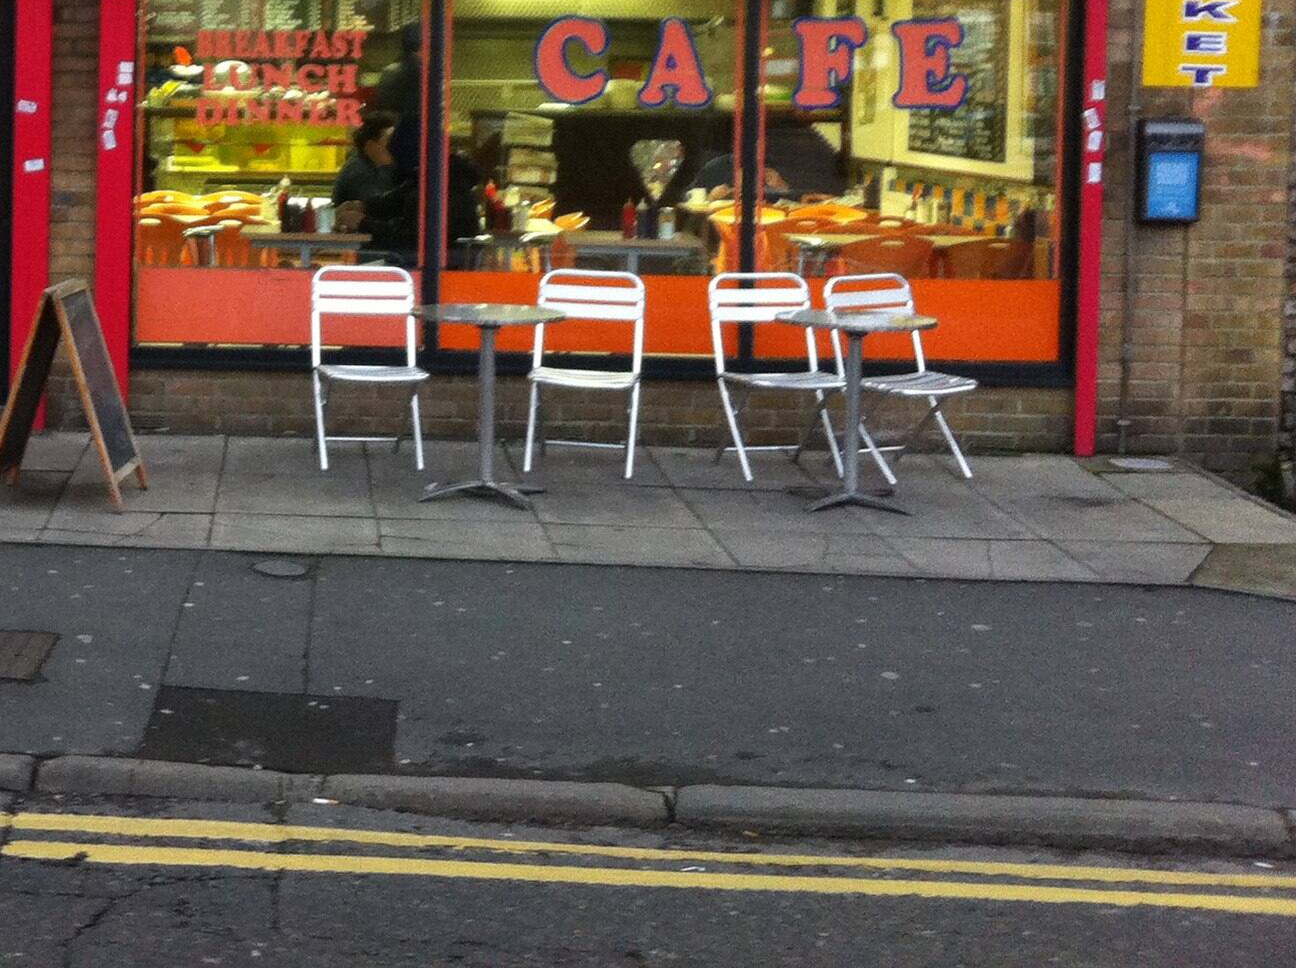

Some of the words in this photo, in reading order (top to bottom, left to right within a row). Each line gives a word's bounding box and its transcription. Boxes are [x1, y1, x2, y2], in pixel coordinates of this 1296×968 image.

[194, 29, 369, 60] BREAKFAST
[533, 13, 969, 110] CAFE
[200, 63, 359, 94] LUNCH
[194, 97, 364, 128] DINNER
